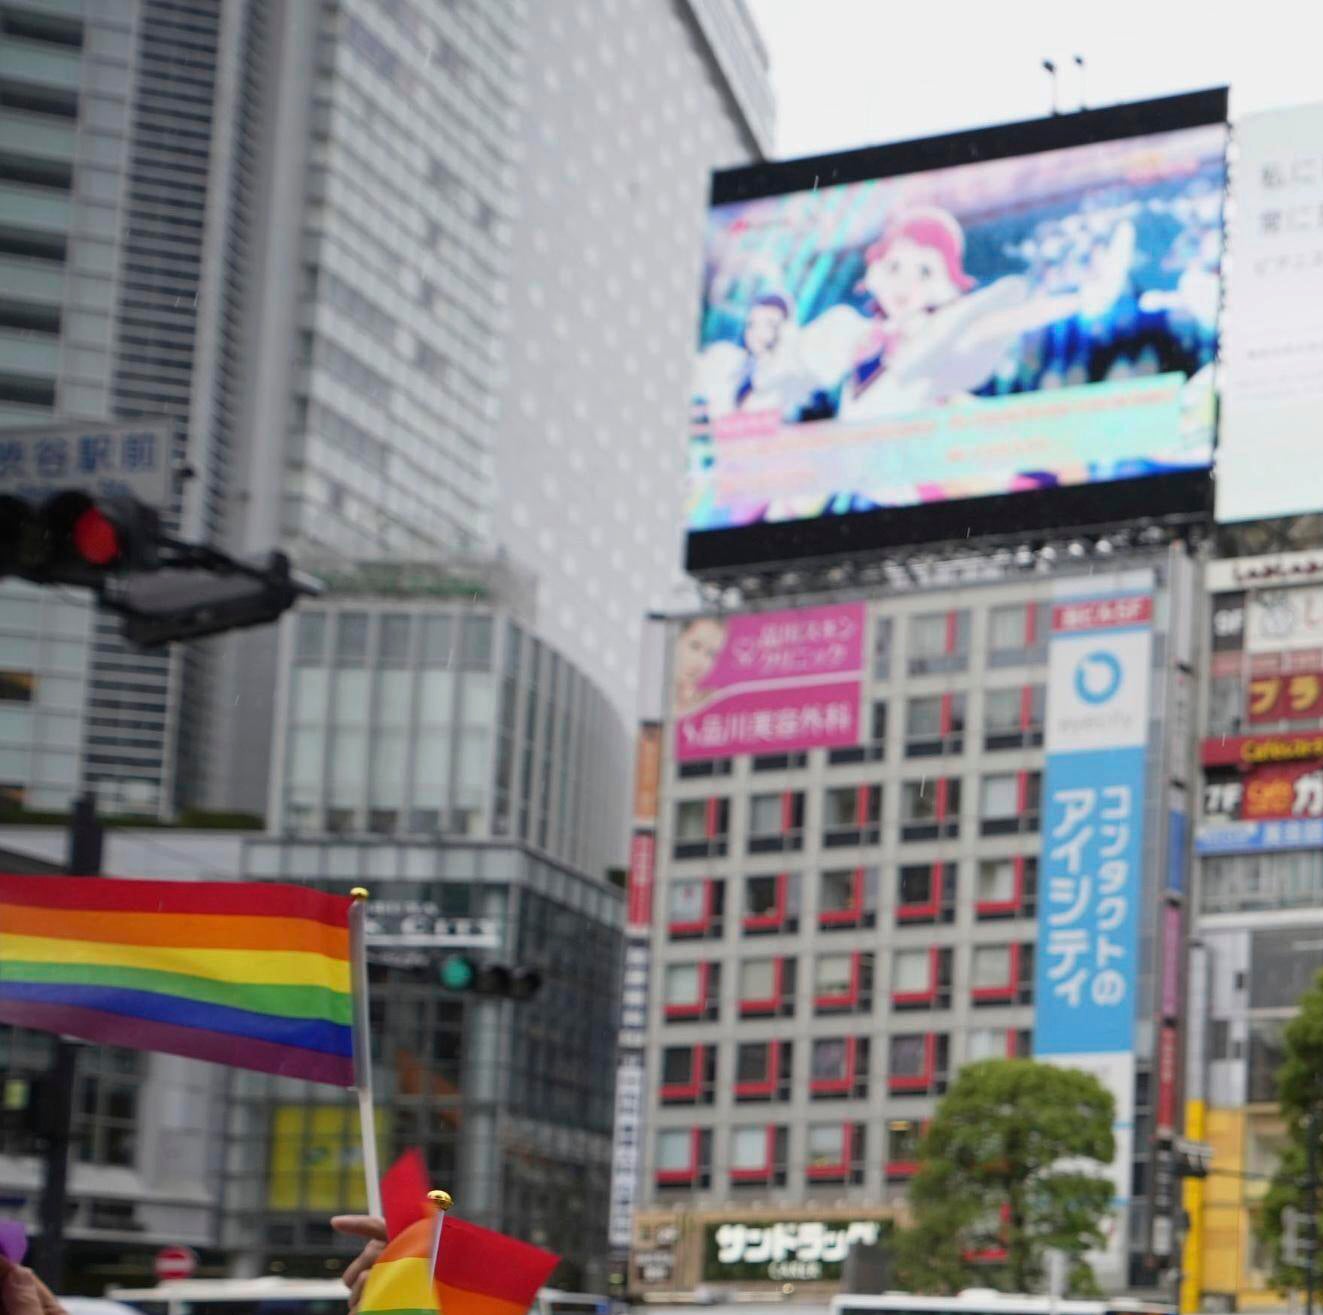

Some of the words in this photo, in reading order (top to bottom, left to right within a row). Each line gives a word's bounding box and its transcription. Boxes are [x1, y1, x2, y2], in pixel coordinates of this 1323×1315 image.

[1048, 788, 1097, 1007] アイシティ
[1093, 785, 1132, 1006] コンタクトの
